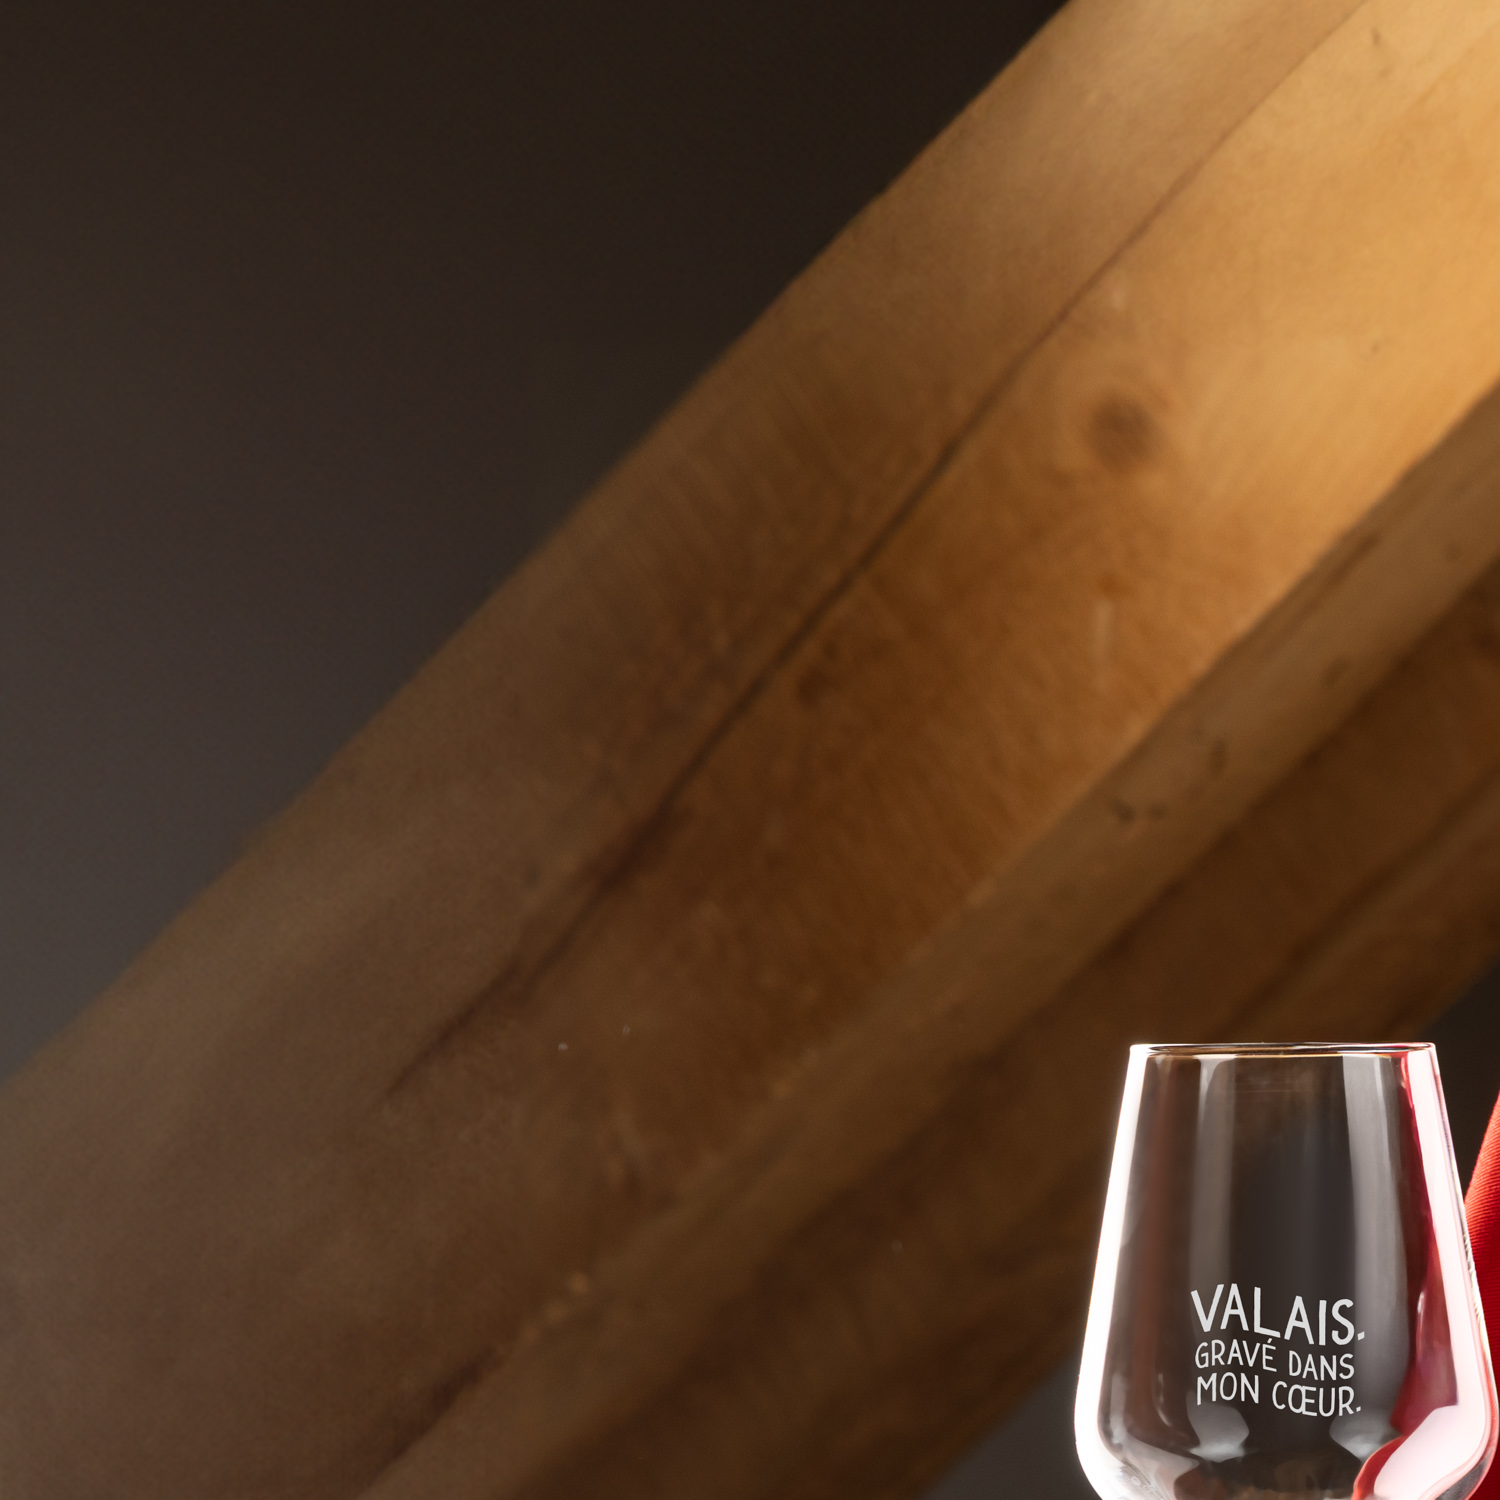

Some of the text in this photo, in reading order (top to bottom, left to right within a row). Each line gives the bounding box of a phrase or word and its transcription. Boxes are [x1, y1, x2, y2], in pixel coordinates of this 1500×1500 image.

[1191, 1283, 1365, 1345] VALAIS.
[1195, 1338, 1354, 1381] GRAVÉ DANS
[1197, 1372, 1361, 1417] MON CŒUR.
